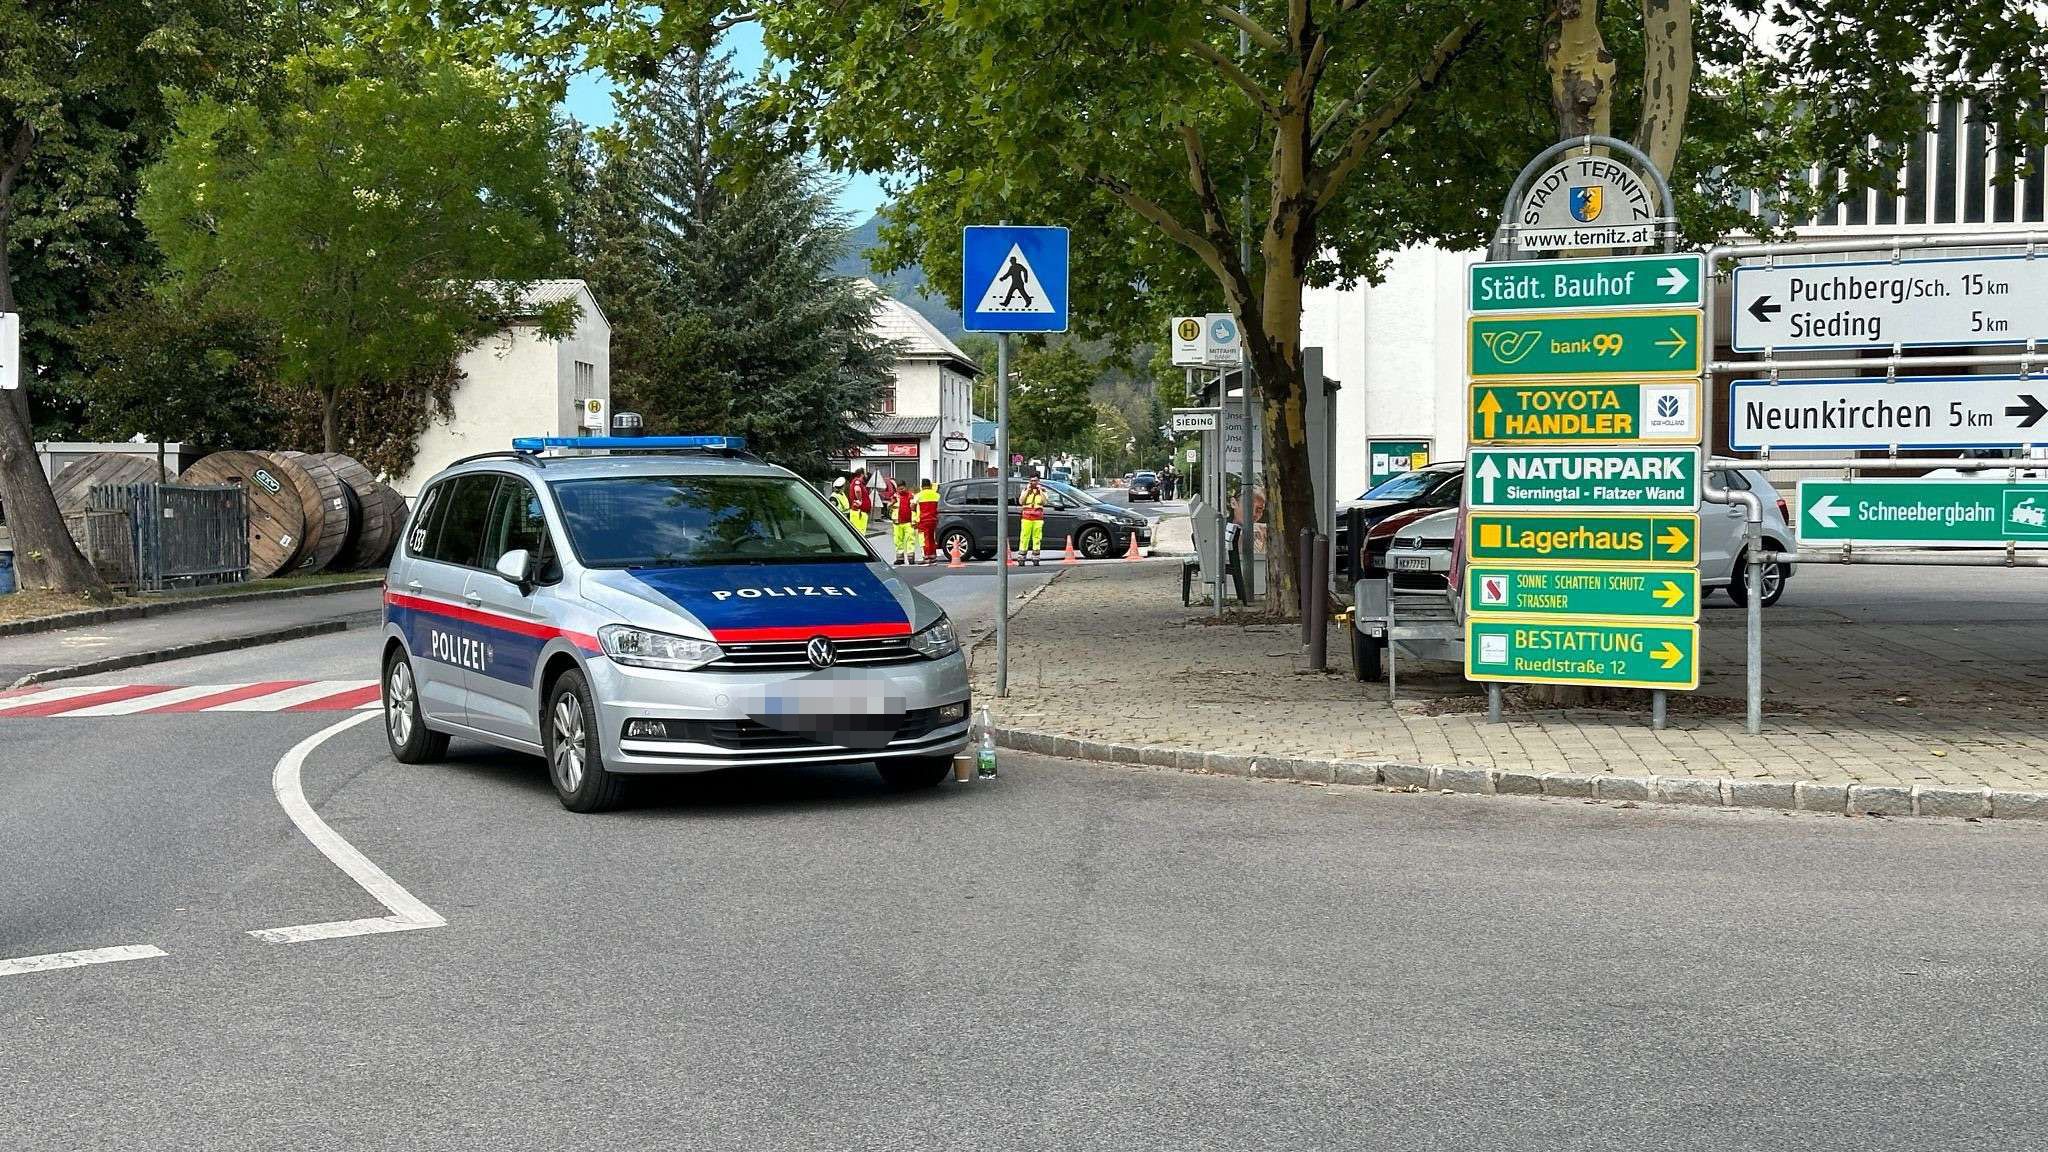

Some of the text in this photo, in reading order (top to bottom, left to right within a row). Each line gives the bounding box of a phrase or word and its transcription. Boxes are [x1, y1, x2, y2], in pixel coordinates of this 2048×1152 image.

[1524, 160, 1649, 225] STADT TERNITZ
[1524, 227, 1648, 247] www.ternitz.at
[1481, 271, 1636, 301] Städt. Bauhof
[1790, 274, 2009, 304] Puchberg/Sch. 15 km
[1790, 310, 2008, 341] Sieding 5 km
[1516, 390, 1621, 410] TOYOTA
[1176, 418, 1213, 426] SIEDING
[1506, 414, 1632, 434] HANDLER
[1746, 398, 1993, 430] Neunkirchen 5 km
[1507, 456, 1685, 480] NATURPARK
[1506, 485, 1580, 502] Sierningtal
[1593, 486, 1642, 499] Flatzer
[1645, 486, 1685, 500] Wand
[1858, 500, 1995, 527] Schneebergbahn
[1506, 524, 1644, 554] Lagerhaus
[711, 586, 858, 601] POLIZEI
[1516, 574, 1548, 589] SONNE
[1554, 576, 1601, 590] SCHATTEN
[1608, 576, 1645, 591] SCHUTZ
[1516, 594, 1568, 608] STRASSNER
[432, 630, 485, 671] POLIZEI
[1515, 630, 1643, 652] BESTATTUNG
[1515, 658, 1626, 675] Ruedlstraße 12
